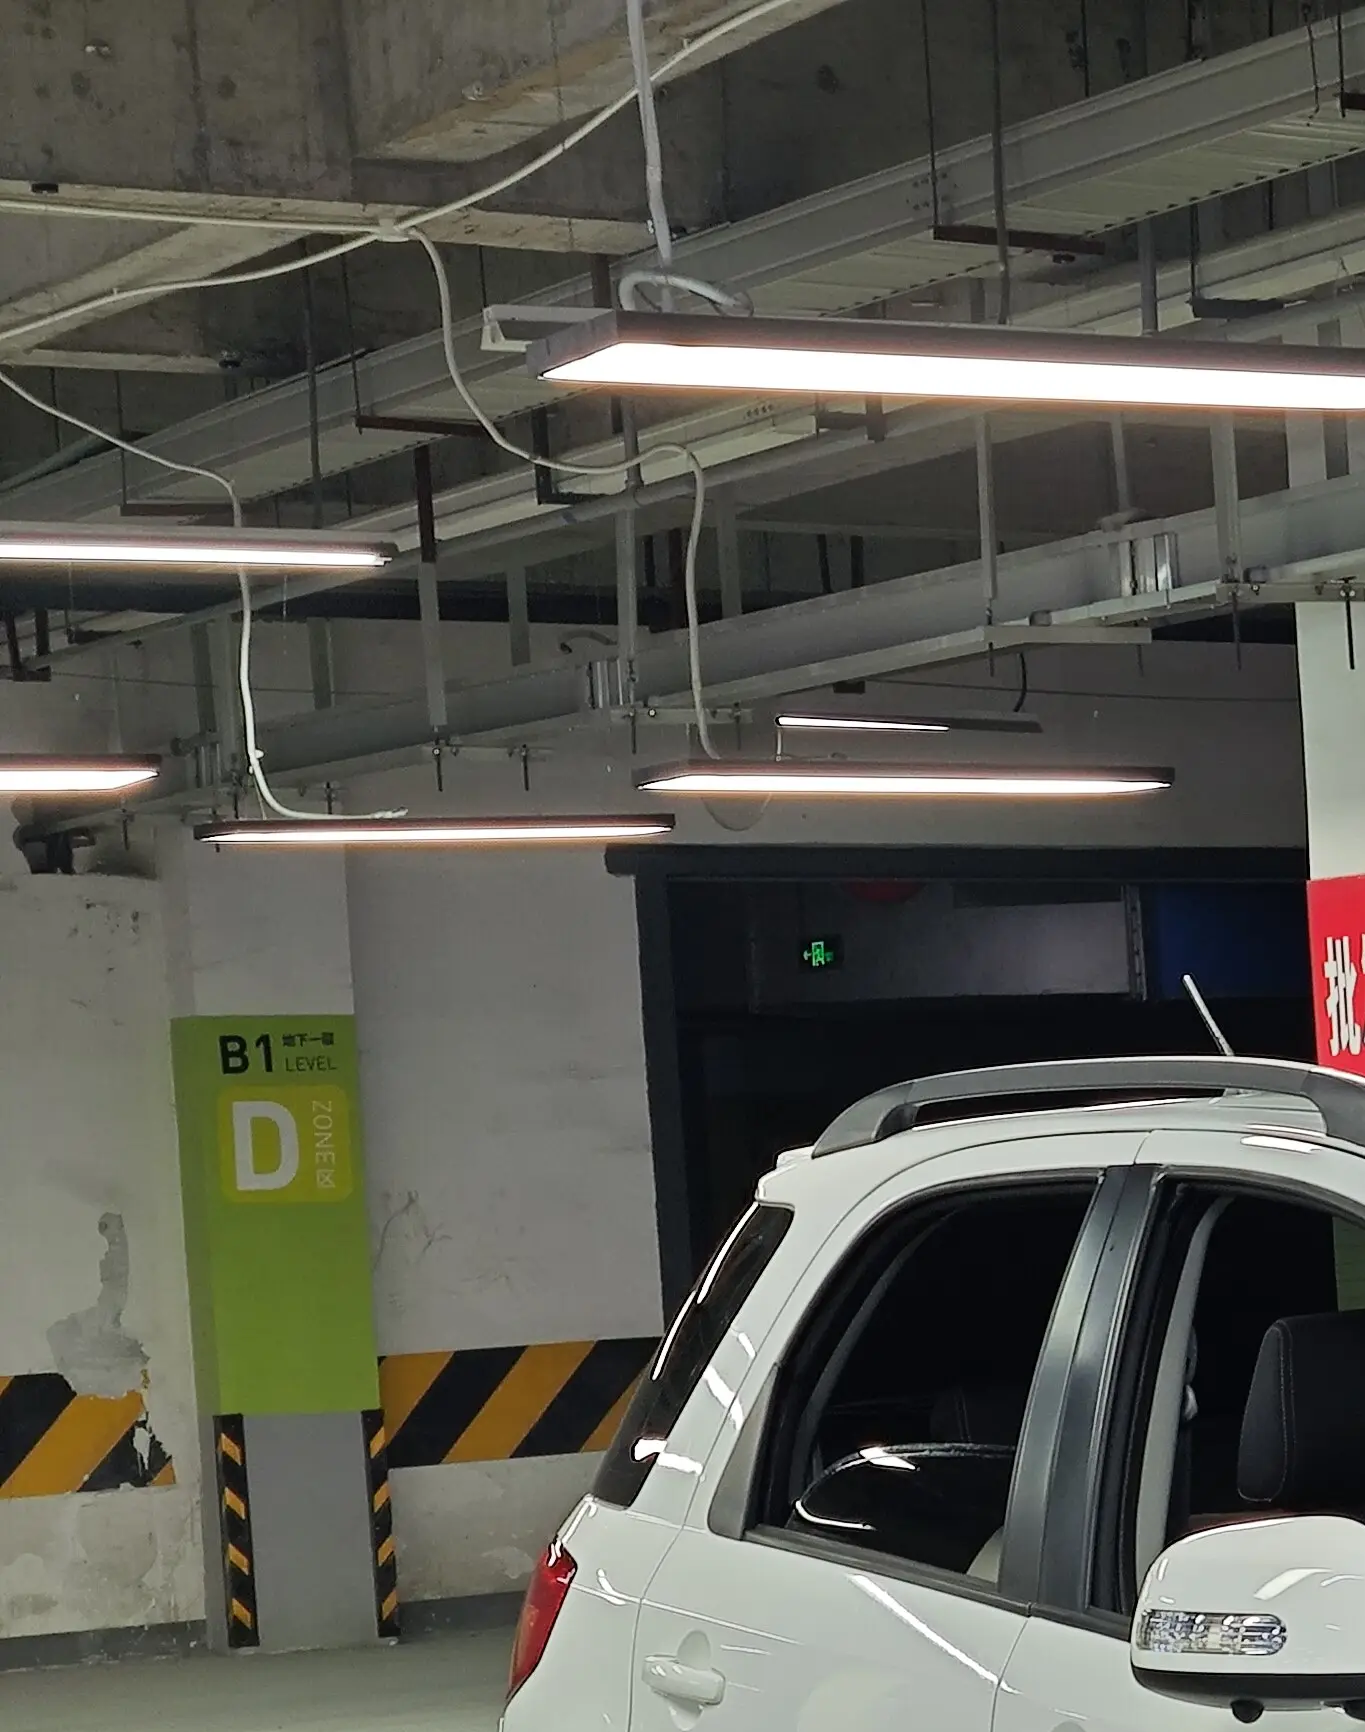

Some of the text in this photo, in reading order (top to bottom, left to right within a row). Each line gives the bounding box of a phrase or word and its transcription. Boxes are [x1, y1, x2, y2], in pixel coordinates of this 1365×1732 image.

[219, 1033, 274, 1075] B1
[285, 1055, 338, 1072] LEVEL
[232, 1100, 300, 1191] D
